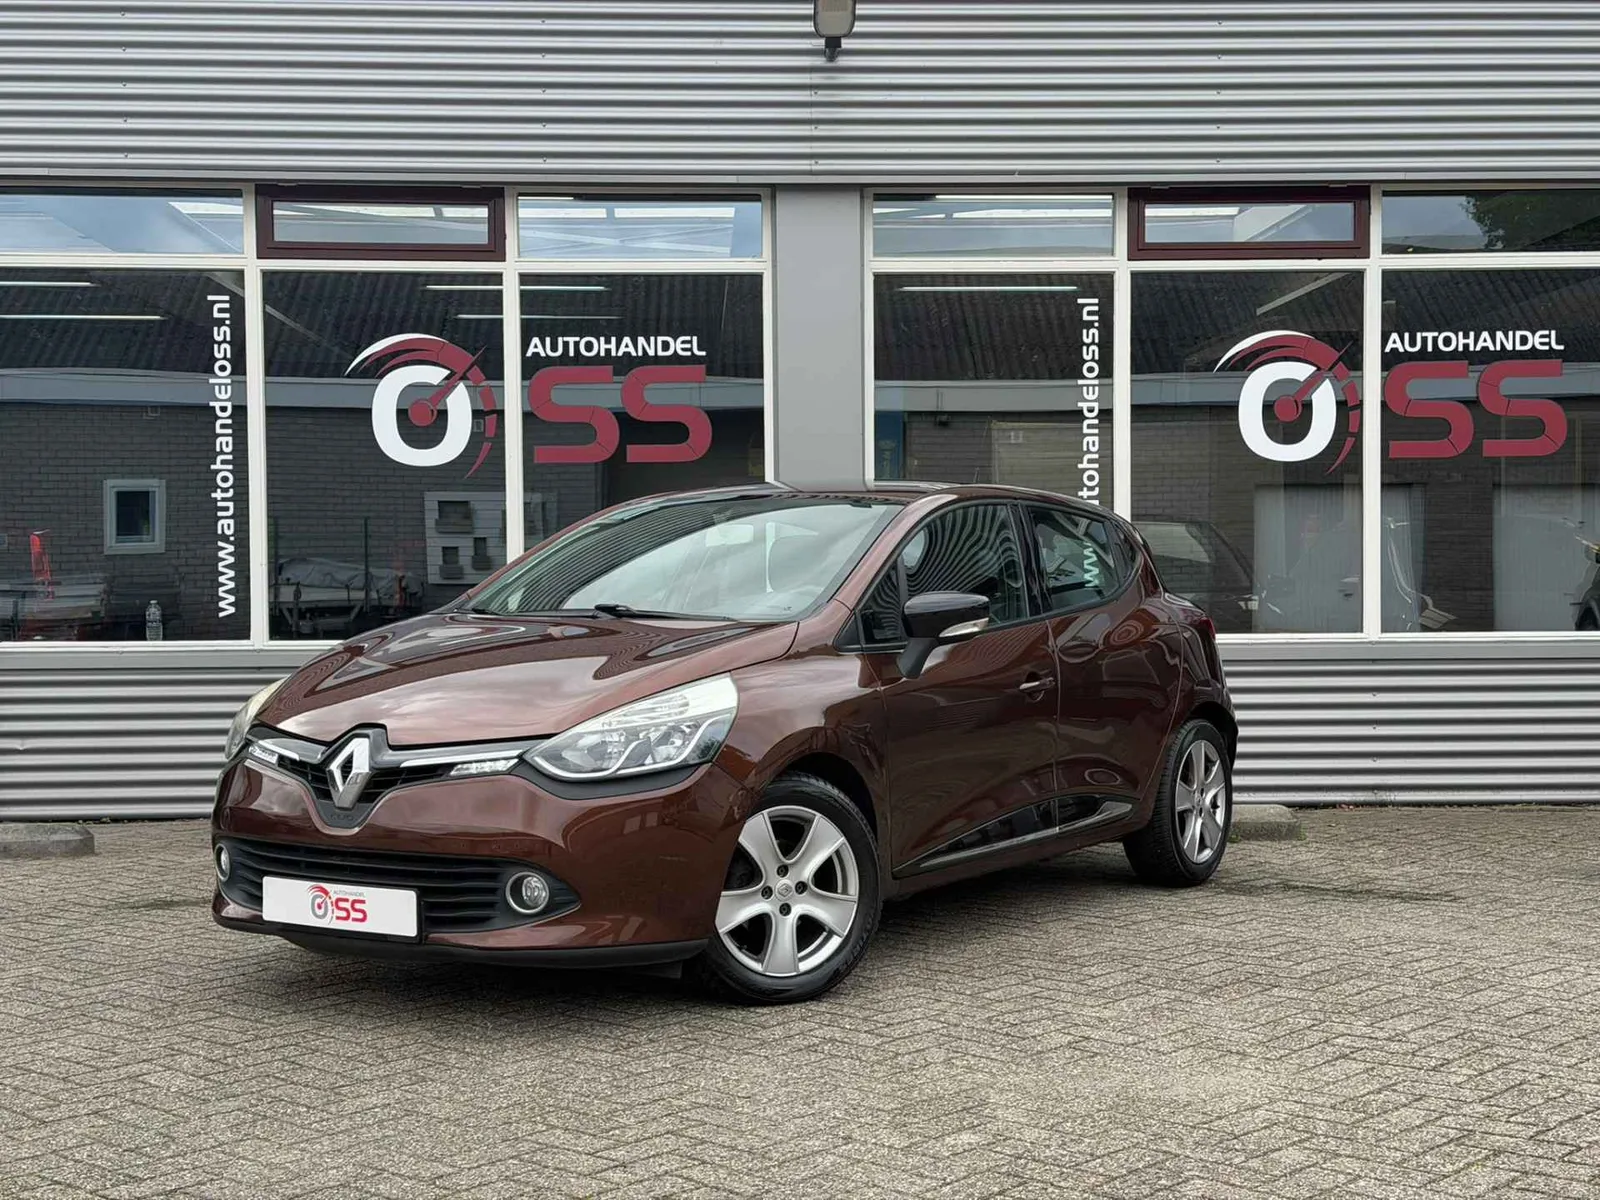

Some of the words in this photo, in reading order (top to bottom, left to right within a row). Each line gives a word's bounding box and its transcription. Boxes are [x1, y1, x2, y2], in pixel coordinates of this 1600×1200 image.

[525, 335, 707, 358] AUTOHANDEL
[1384, 330, 1565, 353] AUTOHANDEL
[207, 295, 236, 618] www.autohandeloss.nl
